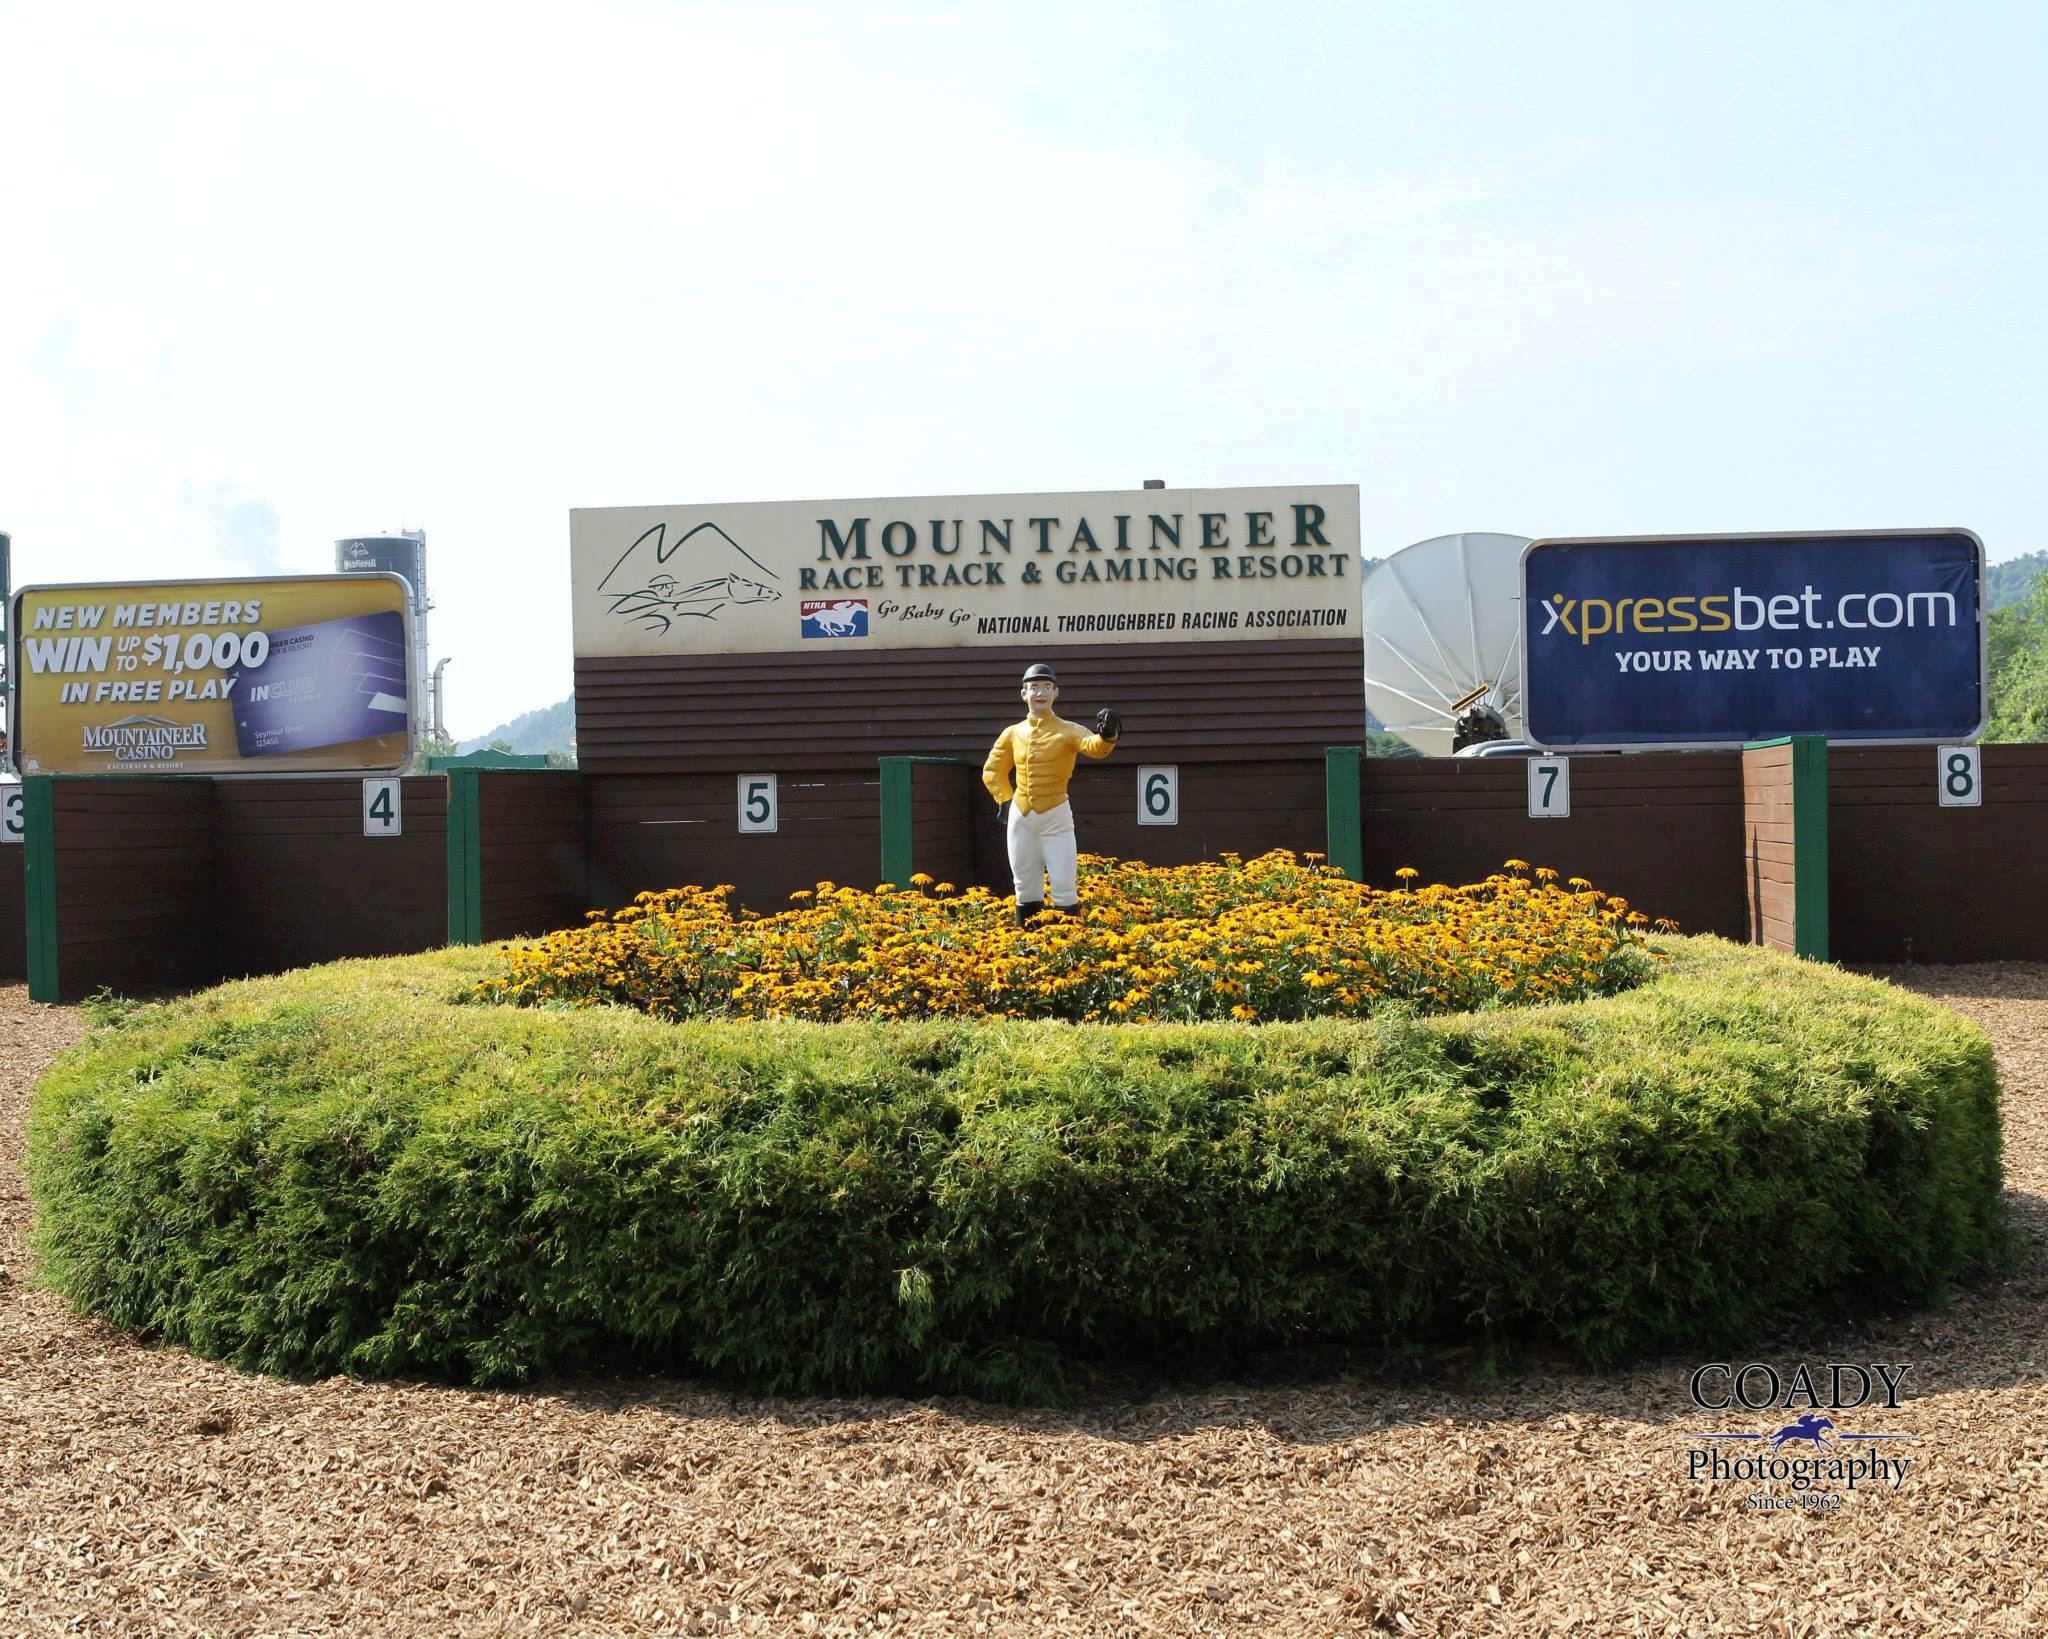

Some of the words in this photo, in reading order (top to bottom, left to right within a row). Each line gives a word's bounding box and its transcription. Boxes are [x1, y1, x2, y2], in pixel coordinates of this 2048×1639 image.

[816, 504, 1332, 560] MOUNTAINEER
[799, 565, 884, 590] RACE
[895, 561, 1006, 587] TRACK
[1021, 561, 1043, 585] &
[1056, 556, 1198, 583] GAMING
[1211, 553, 1349, 580] RESORT
[33, 605, 106, 630] NEW
[112, 600, 261, 628] MEMBERS
[877, 600, 899, 619] Go
[900, 602, 945, 621] Baby
[949, 608, 971, 628] Go
[977, 616, 1050, 634] NATIONAL
[1058, 612, 1176, 632] THOROUGHBRED
[1181, 611, 1238, 630] RACING
[1245, 608, 1347, 628] ASSOCIATION
[1541, 585, 1956, 645] xpressbet.com
[26, 635, 112, 674] WIN
[117, 636, 141, 652] UP
[142, 631, 270, 675] $1,000
[1615, 650, 1692, 673] YOUR
[1699, 649, 1760, 670] WAY
[1767, 648, 1804, 669] TO
[1809, 646, 1881, 668] PLAY
[116, 655, 138, 672] TO
[60, 682, 89, 703] IN
[95, 680, 162, 702] FREE
[168, 678, 237, 700] PLAY
[82, 724, 207, 747] MOUNTAINEER
[115, 746, 174, 761] CASINO
[1538, 766, 1560, 808] 7
[1946, 753, 1974, 797] 8
[6, 794, 24, 834] 3
[369, 787, 394, 826] 4
[746, 782, 771, 823] 5
[1144, 775, 1170, 815] 6
